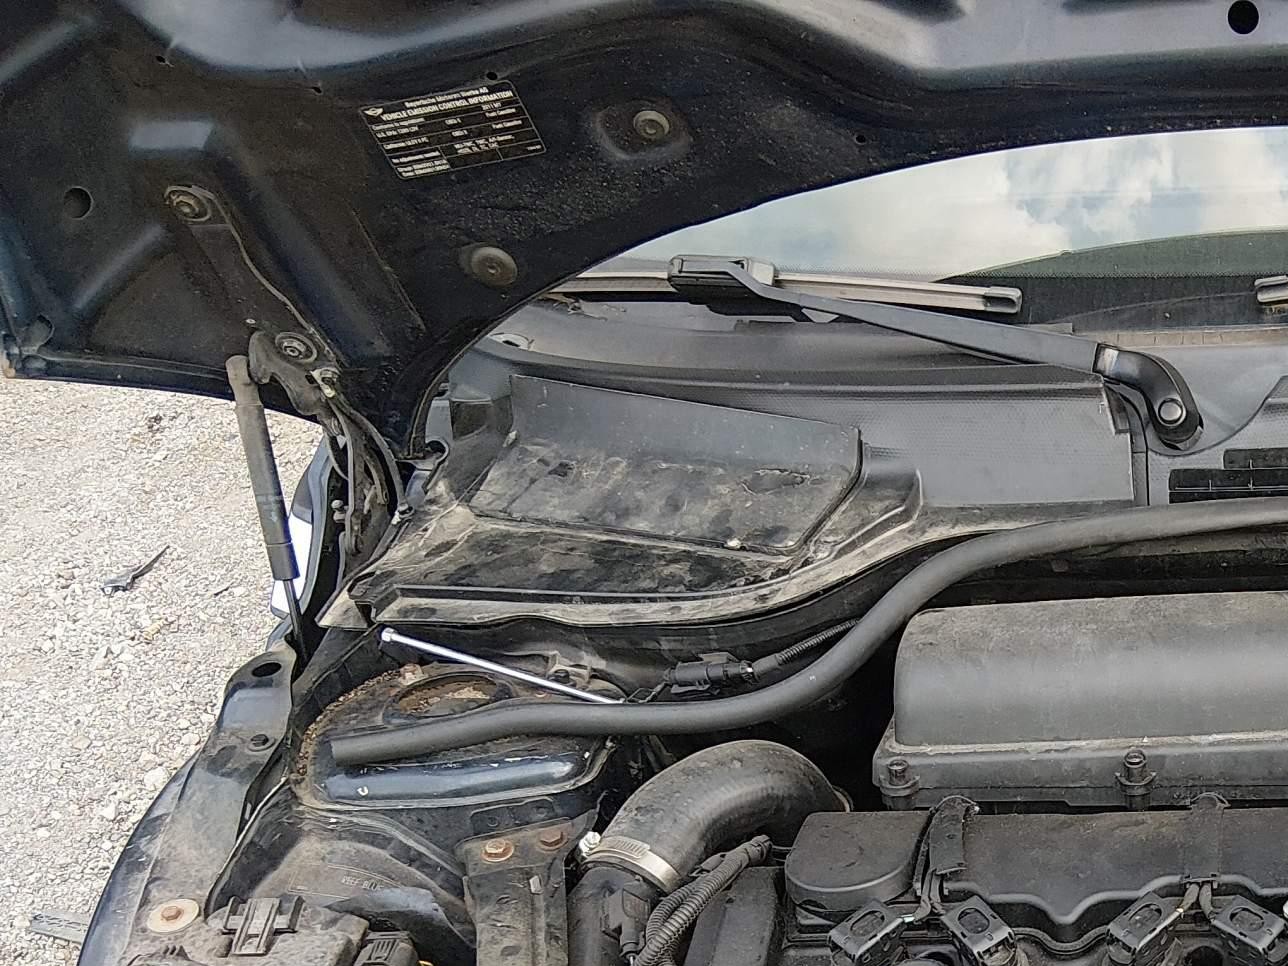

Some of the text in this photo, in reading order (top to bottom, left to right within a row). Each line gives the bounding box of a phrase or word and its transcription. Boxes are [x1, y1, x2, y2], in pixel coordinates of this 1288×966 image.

[380, 90, 513, 121] VEHICLE EMISSION CONTROL INFORMATION
